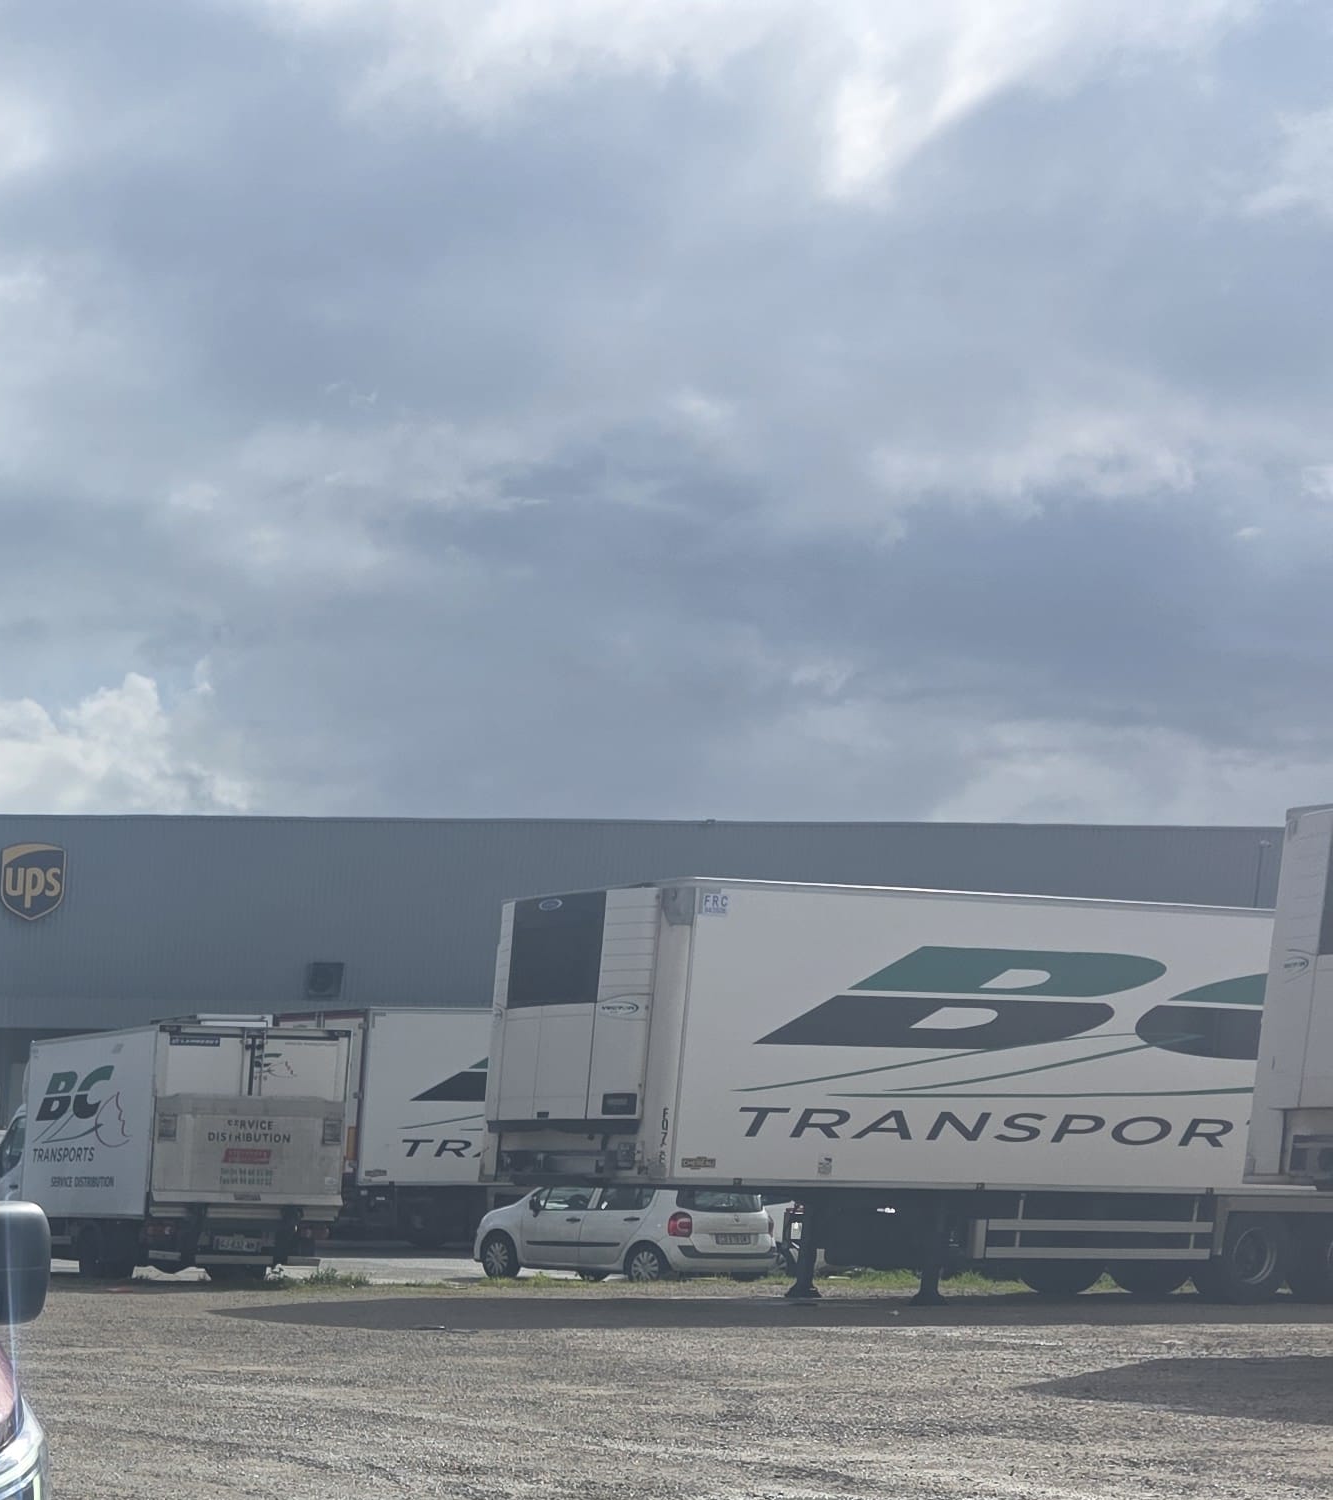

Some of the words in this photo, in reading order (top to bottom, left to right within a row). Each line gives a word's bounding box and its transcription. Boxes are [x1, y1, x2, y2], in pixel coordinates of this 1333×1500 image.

[5, 867, 61, 908] ups
[704, 895, 729, 907] FRC
[35, 1065, 115, 1121] BC
[738, 1106, 1250, 1148] TRANSPOR
[207, 1131, 291, 1143] DISTRIBUTION
[33, 1147, 95, 1163] TRANSPORTS
[402, 1139, 482, 1158] TR
[50, 1177, 73, 1188] SERVICE
[74, 1176, 114, 1188] DISTRIBUTION
